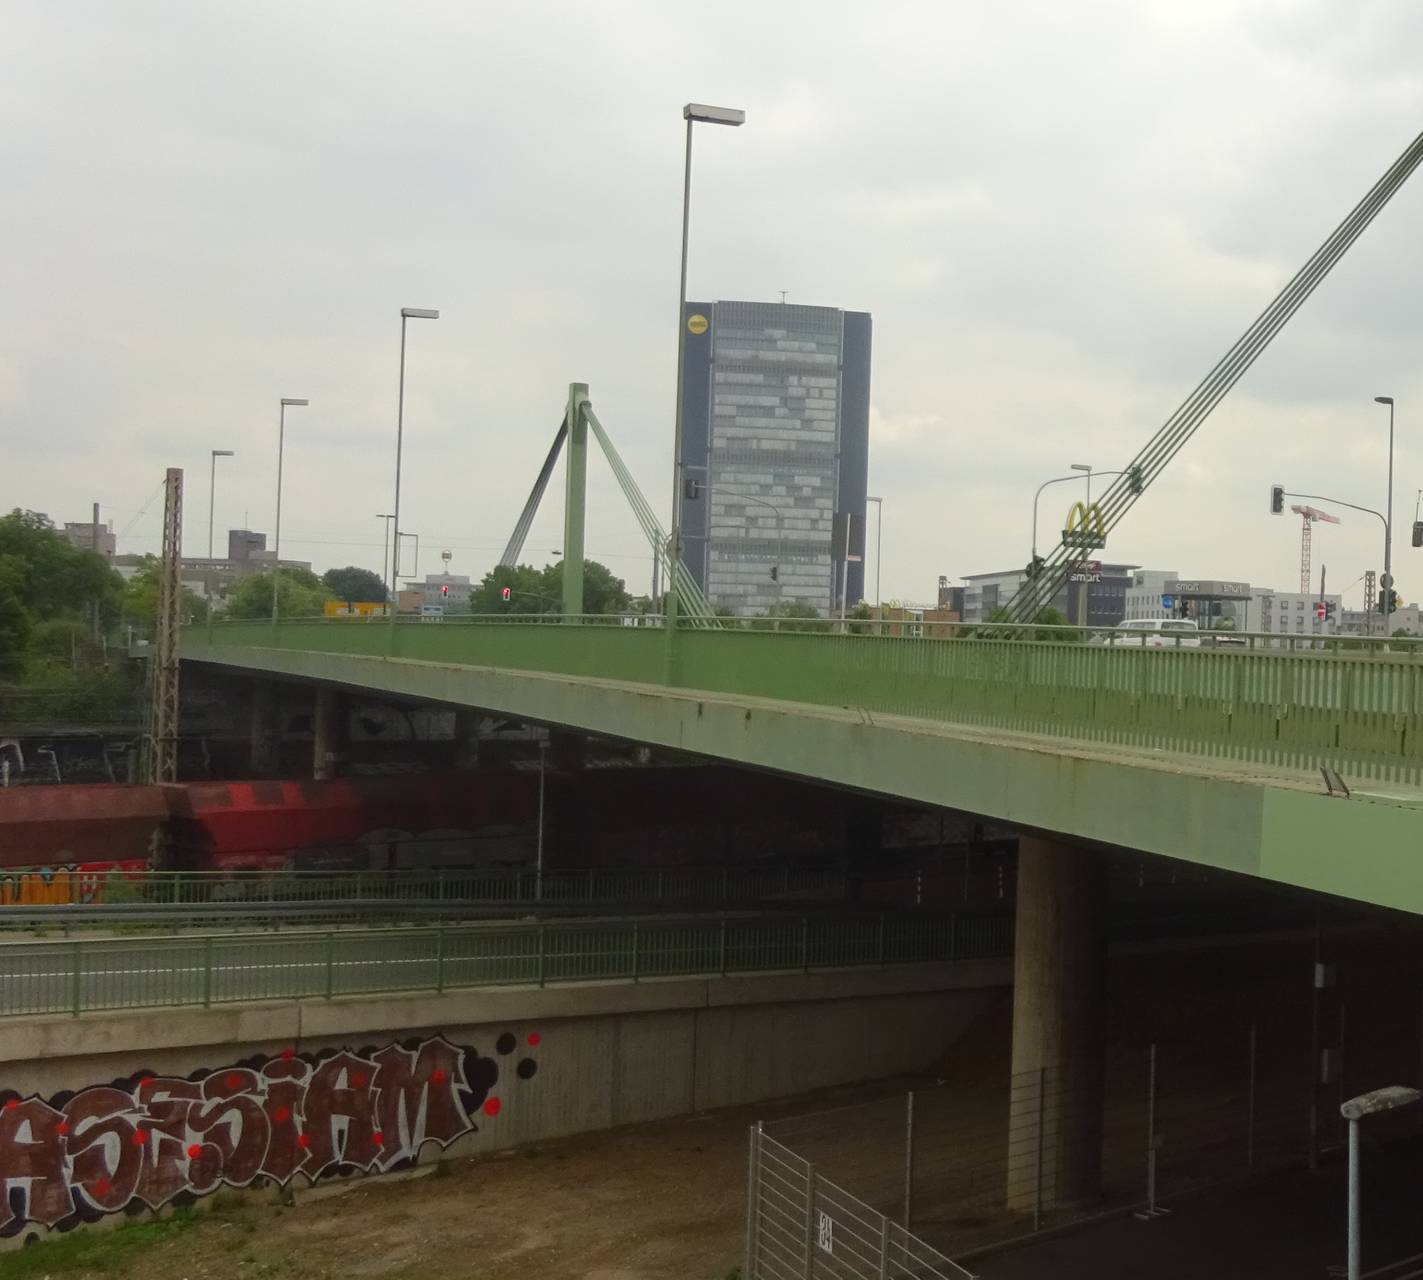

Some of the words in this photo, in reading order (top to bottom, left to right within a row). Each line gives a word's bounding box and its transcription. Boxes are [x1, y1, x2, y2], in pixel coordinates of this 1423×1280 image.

[1070, 573, 1101, 582] smart
[1175, 583, 1200, 592] smart
[1223, 583, 1242, 593] smart
